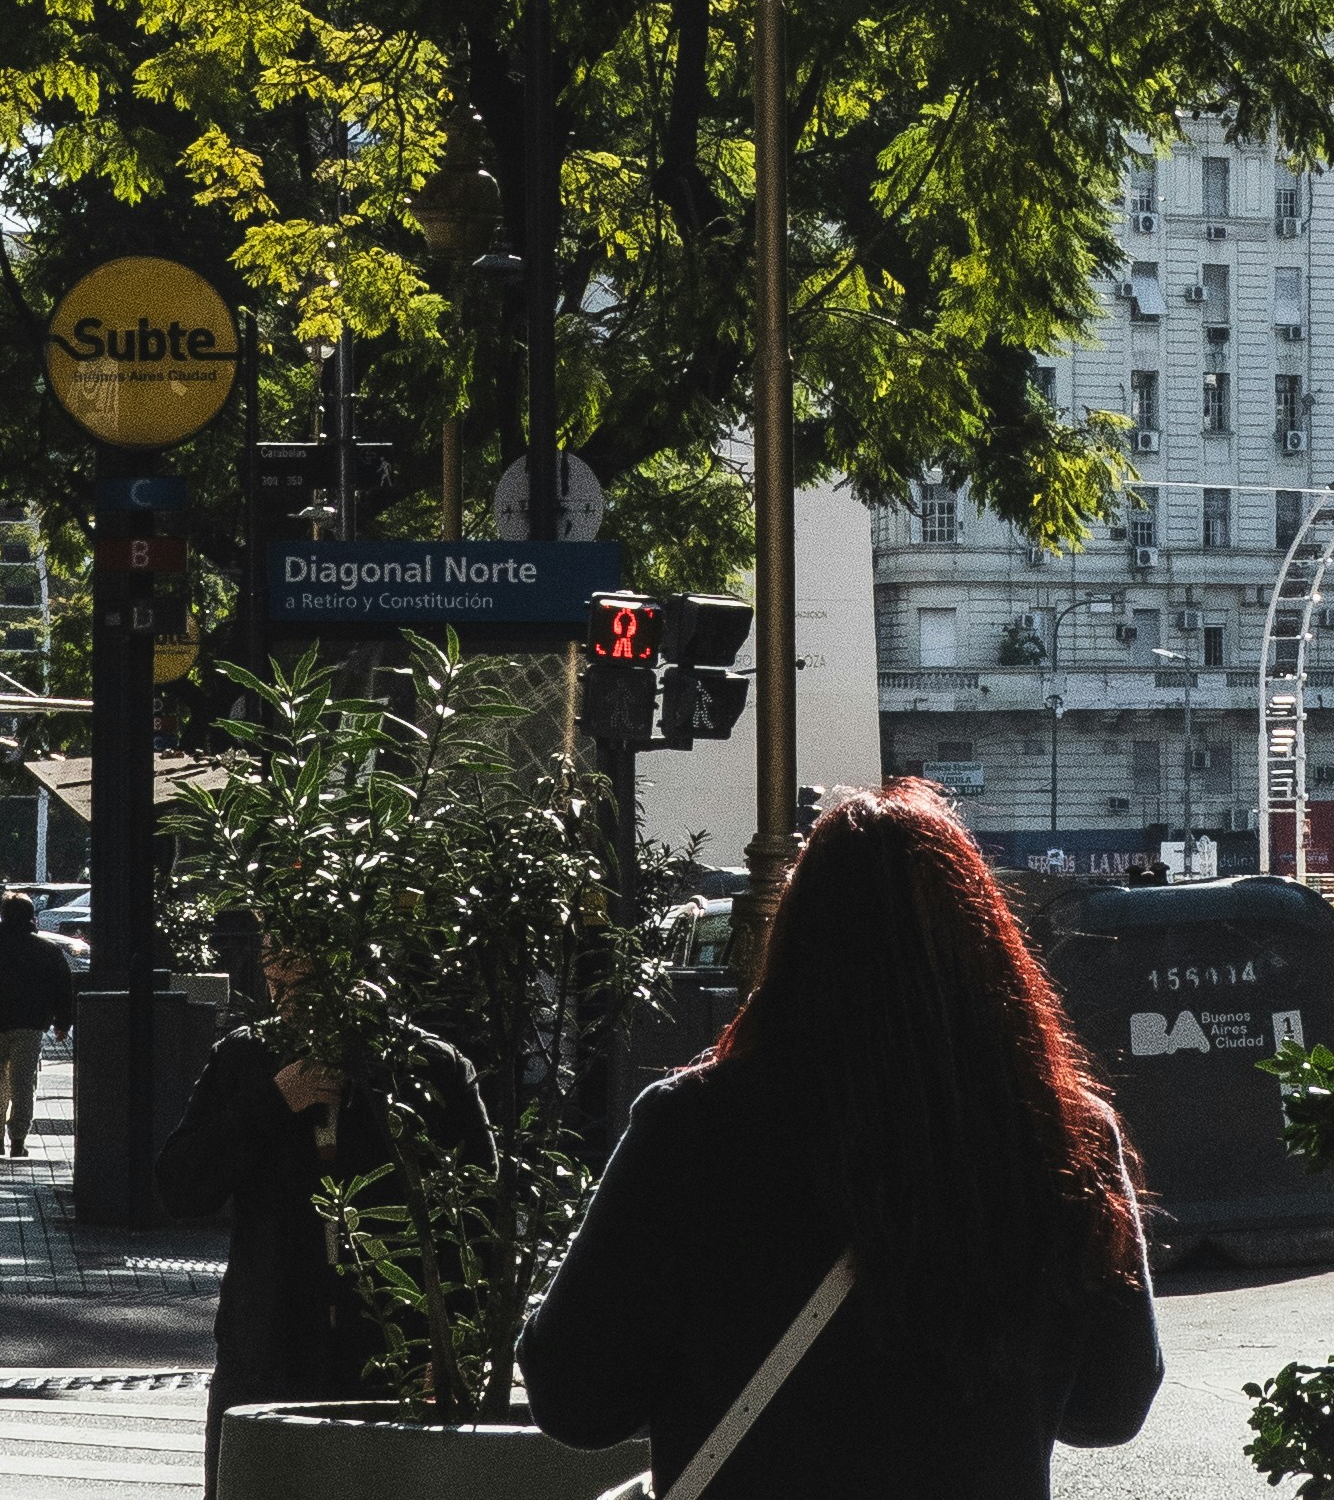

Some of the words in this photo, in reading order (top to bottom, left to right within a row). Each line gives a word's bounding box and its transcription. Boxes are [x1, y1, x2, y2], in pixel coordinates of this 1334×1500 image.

[69, 317, 217, 362] Subte
[128, 370, 165, 382] Aires
[167, 369, 216, 382] Ciudad
[130, 478, 151, 507] C
[130, 539, 150, 568] B
[284, 554, 433, 591] Diagonal
[444, 555, 538, 584] Norte
[285, 596, 296, 609] a
[302, 593, 357, 609] Retiro
[363, 596, 374, 613] y
[379, 592, 494, 609] Constitución
[1129, 1010, 1211, 1056] BA
[1201, 1012, 1251, 1024] Buenos
[1210, 1024, 1248, 1036] Aires
[1215, 1034, 1265, 1049] Ciudad
